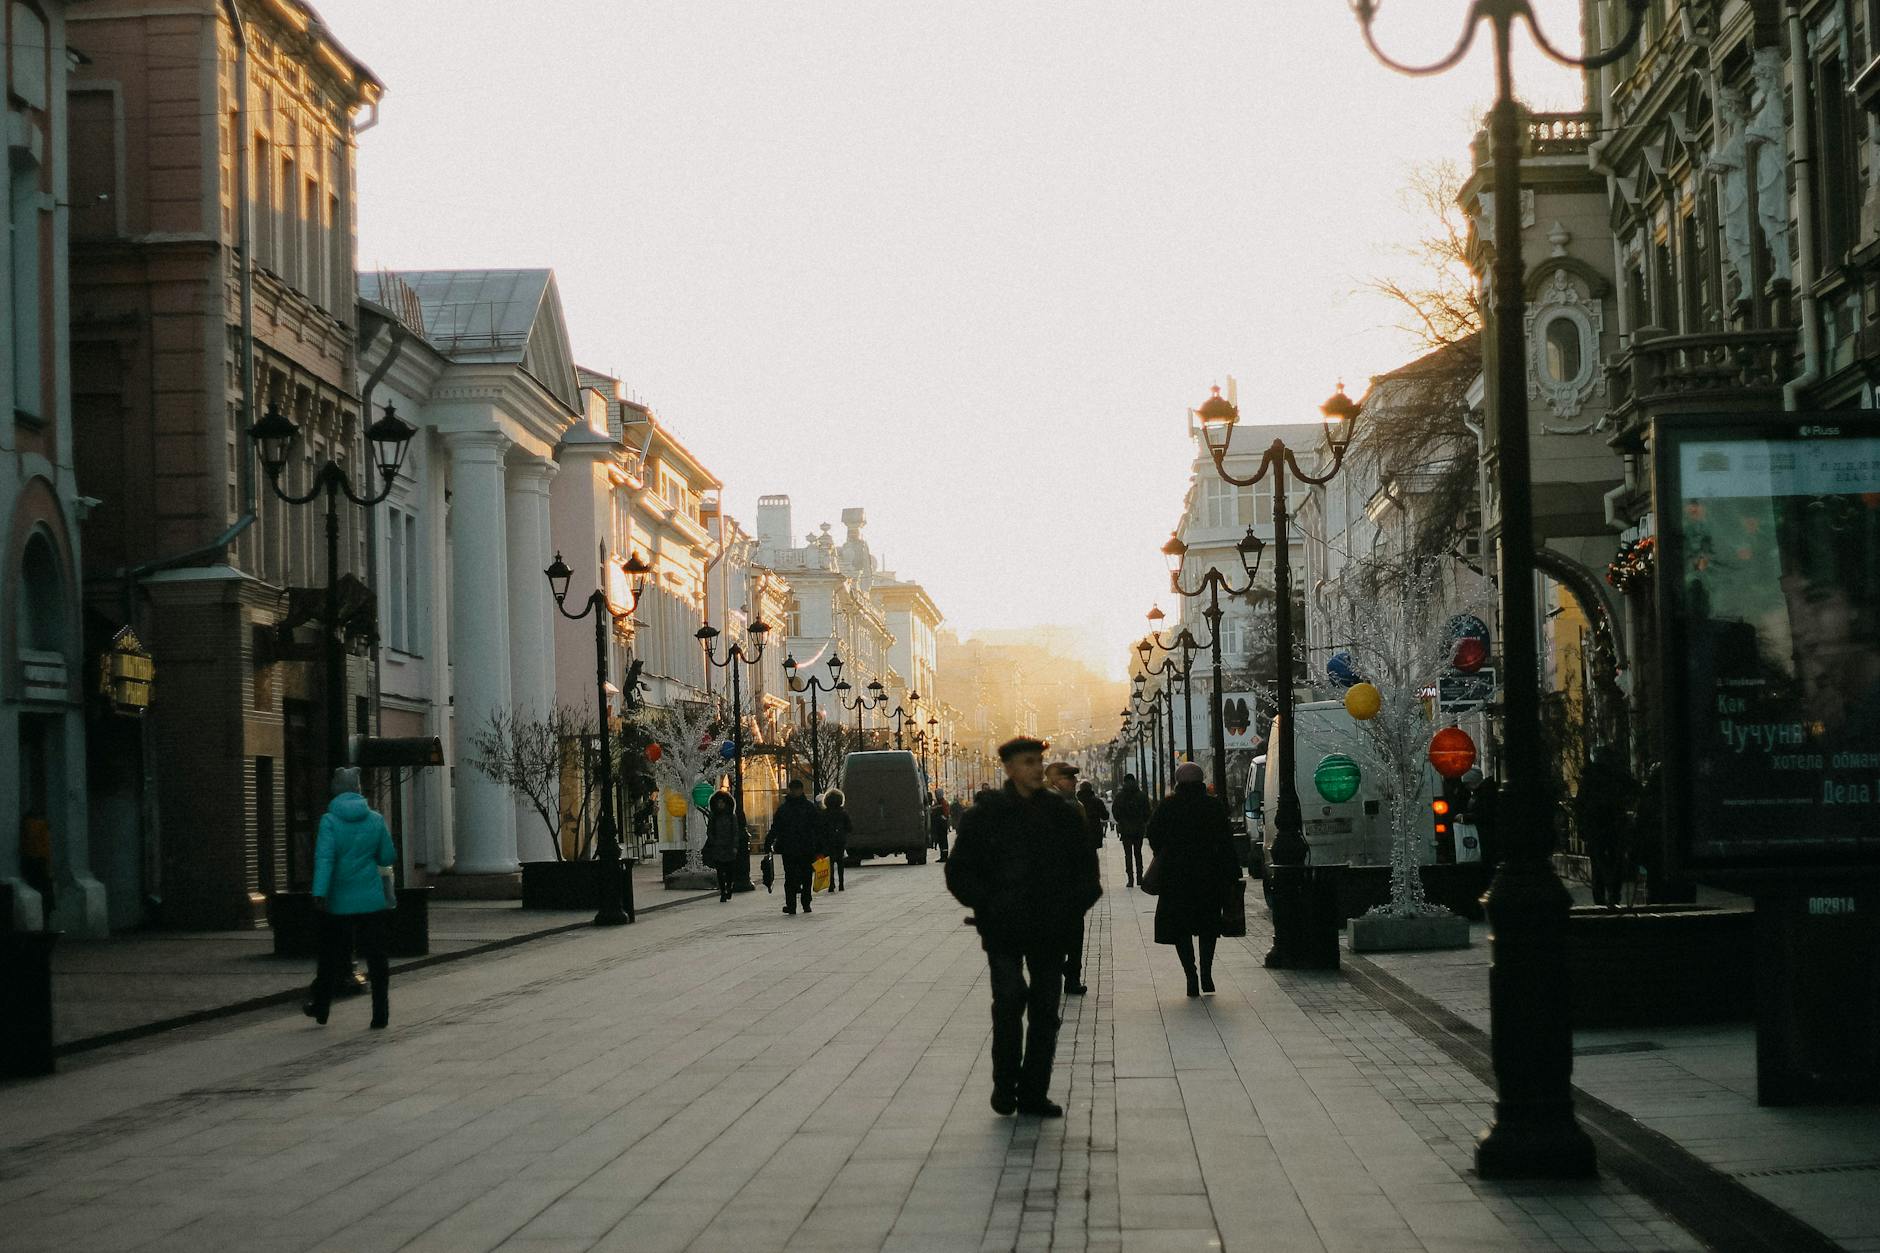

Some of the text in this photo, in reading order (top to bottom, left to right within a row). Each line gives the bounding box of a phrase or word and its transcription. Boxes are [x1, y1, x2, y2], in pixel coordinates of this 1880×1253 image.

[1812, 425, 1840, 435] Russ
[1717, 694, 1747, 713] Как
[1773, 751, 1880, 769] хотела обман
[1822, 780, 1870, 804] Деда
